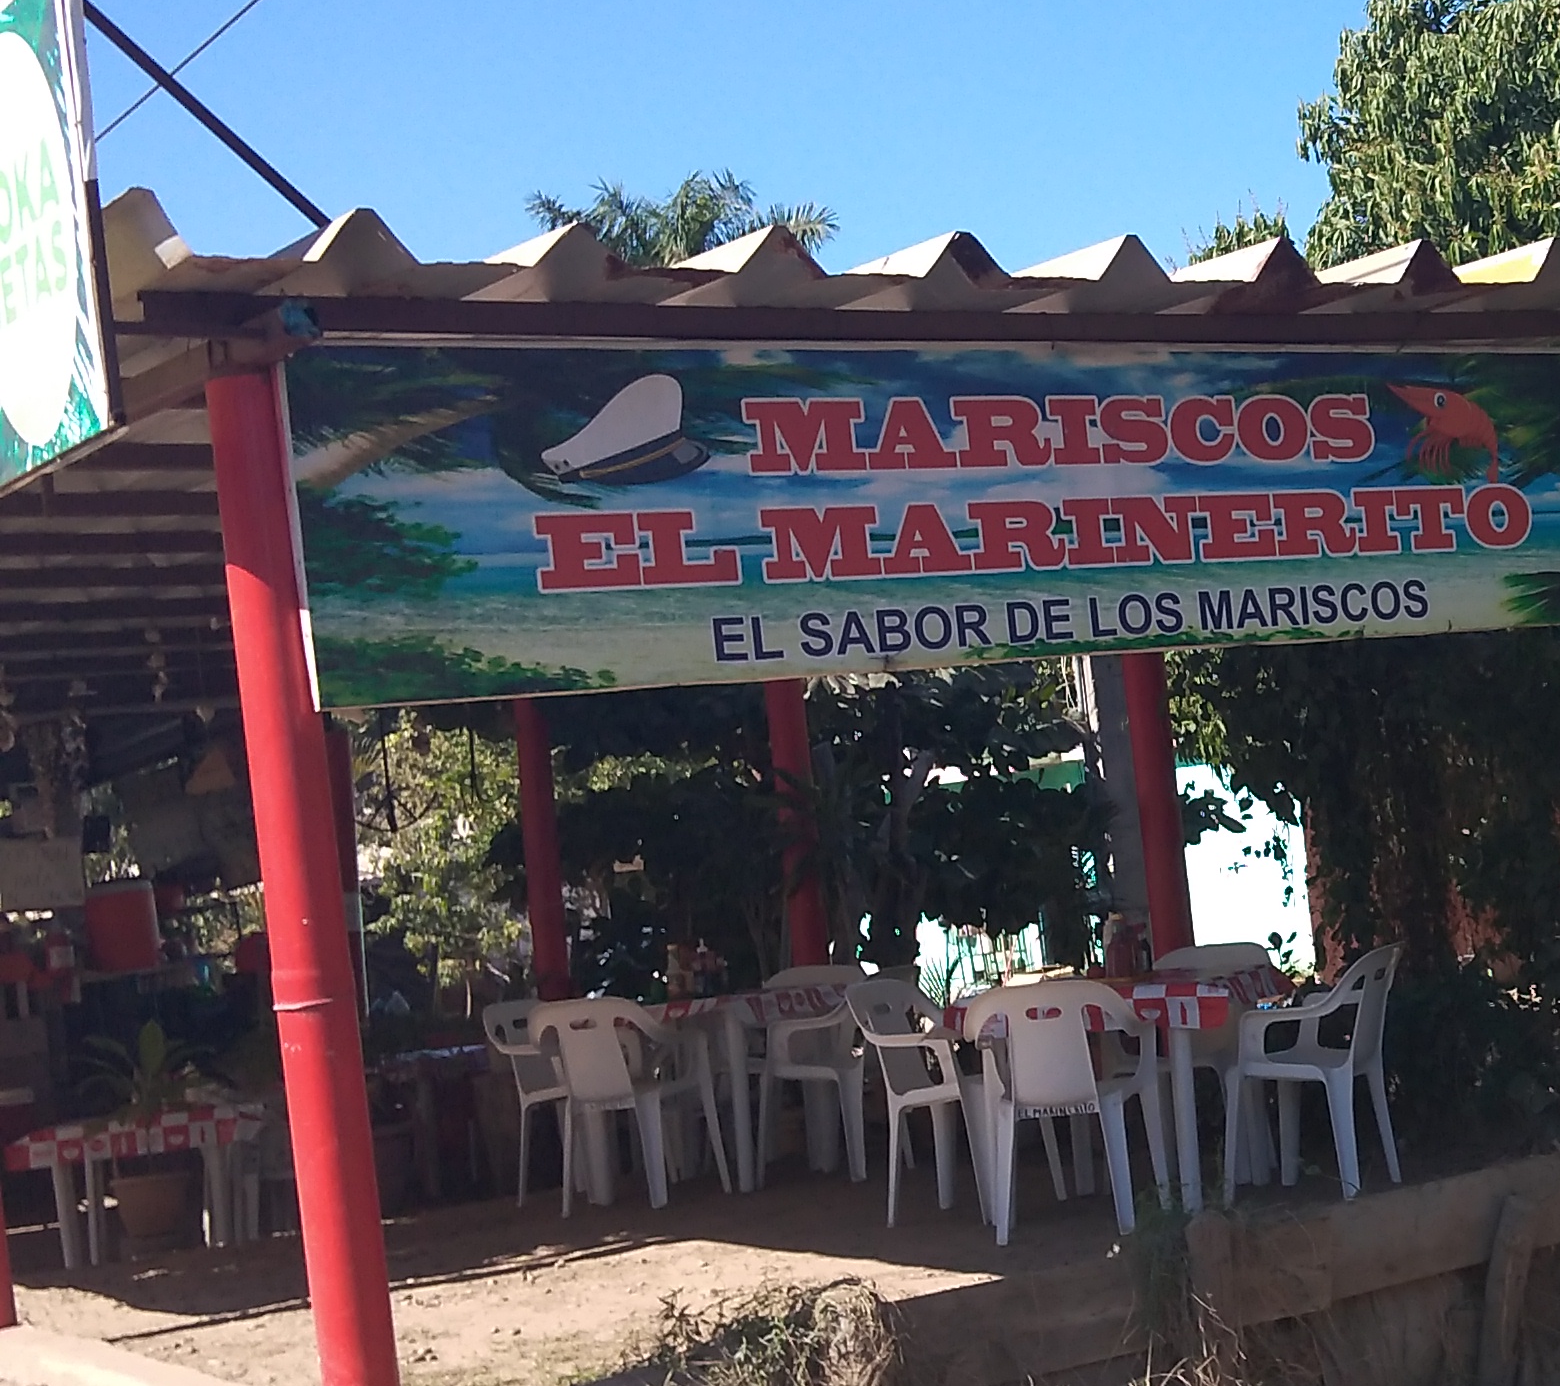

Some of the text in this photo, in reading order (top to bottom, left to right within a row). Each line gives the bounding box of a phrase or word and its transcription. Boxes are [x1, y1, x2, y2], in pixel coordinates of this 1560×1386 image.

[741, 393, 1375, 476] MARISCOS
[533, 483, 1532, 594] EL MARINERITO
[712, 579, 1429, 662] EL SABOR DE LOS MARISCOS
